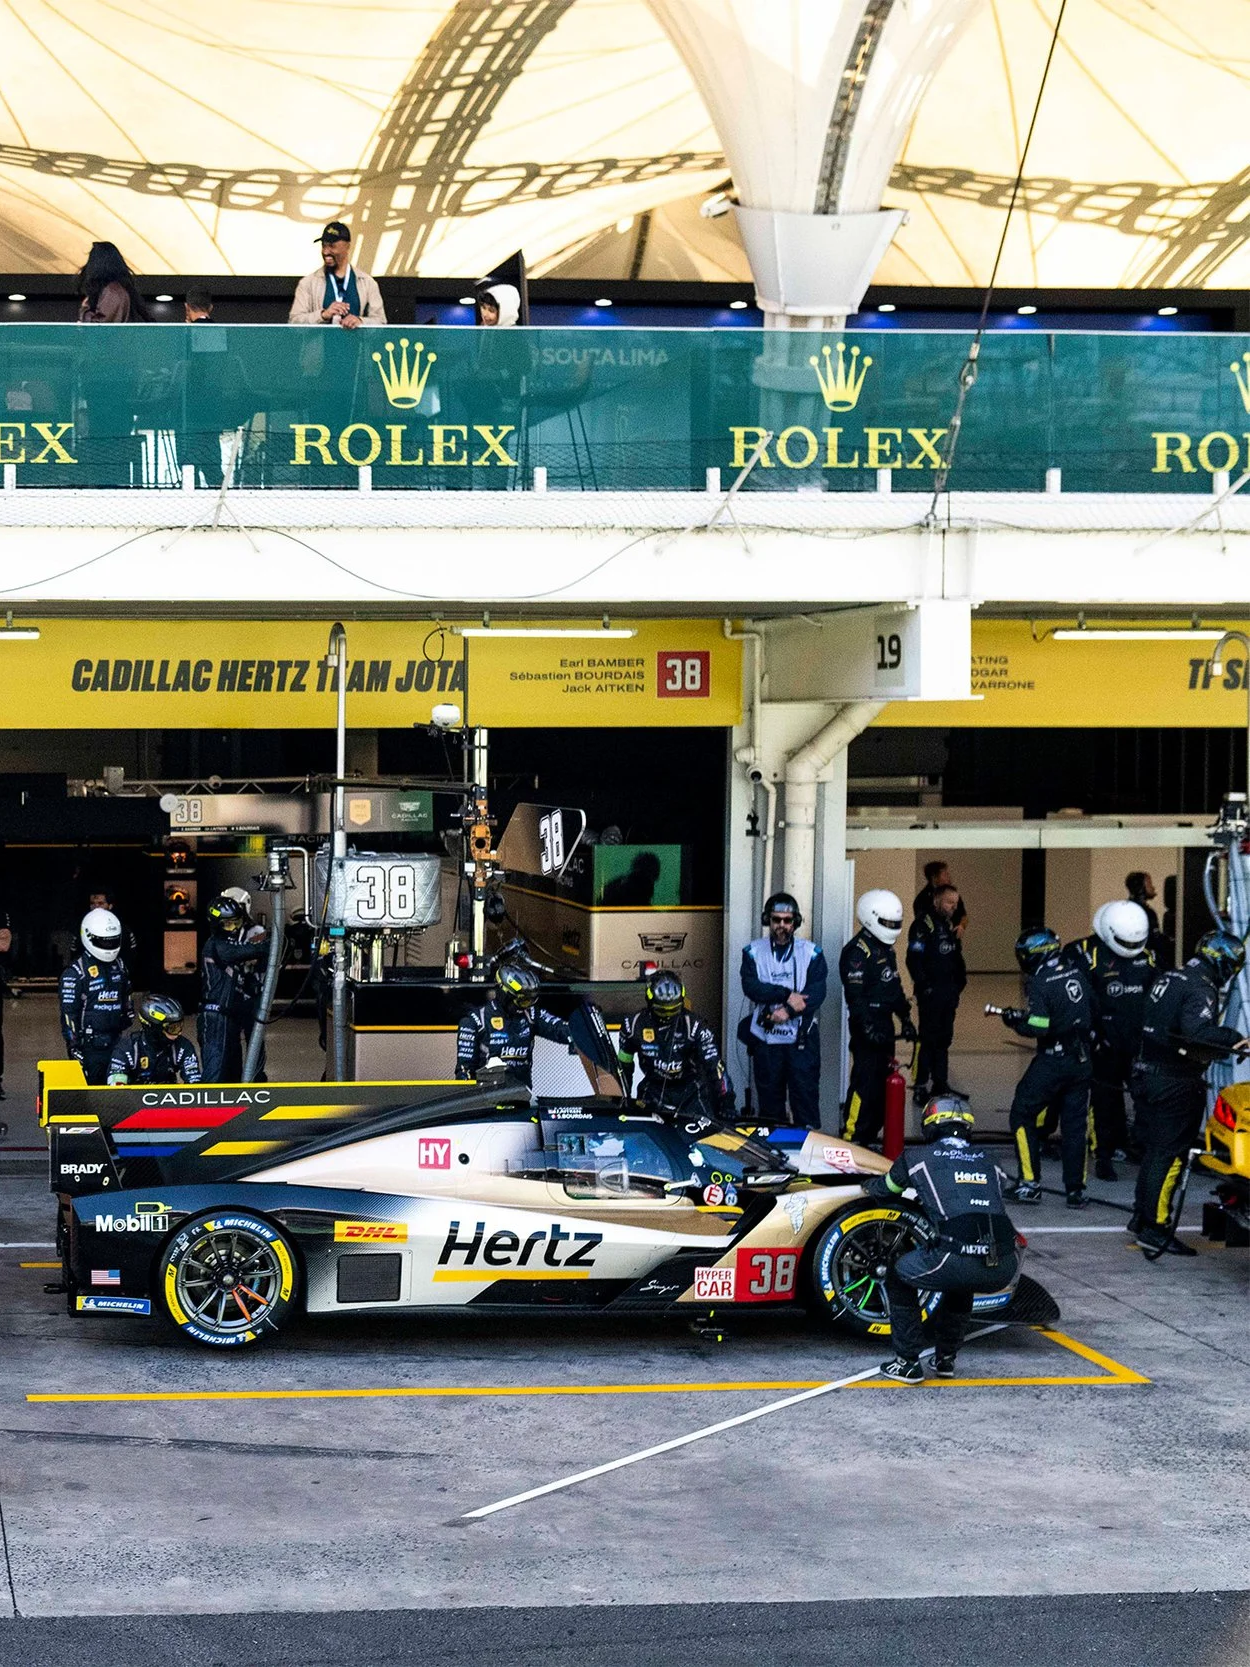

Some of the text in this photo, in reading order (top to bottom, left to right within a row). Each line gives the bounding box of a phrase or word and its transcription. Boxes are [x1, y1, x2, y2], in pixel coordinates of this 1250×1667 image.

[289, 424, 517, 466] ROLEX
[728, 427, 949, 469] ROLEX
[1151, 432, 1250, 473] RO
[877, 635, 901, 669] 19
[560, 659, 645, 667] Earl BAMBER
[71, 659, 213, 692] CADILLAC
[217, 660, 310, 692] HERTZ
[395, 660, 465, 693] JOTA
[510, 671, 645, 680] Sébastien BOURDAIS
[666, 659, 701, 690] 38
[562, 684, 645, 693] Jack AITKEN
[175, 799, 202, 823] 38
[539, 809, 564, 876] 38
[357, 865, 416, 920] 38
[98, 991, 118, 1000] Hertz
[501, 1046, 528, 1056] Hertz
[654, 1060, 683, 1071] Hertz
[142, 1091, 271, 1105] CADILLAC
[758, 1128, 769, 1136] 38
[420, 1143, 449, 1166] HY
[60, 1164, 103, 1174] BRADY
[955, 1171, 987, 1181] Hertz
[95, 1214, 150, 1232] Mobil
[224, 1219, 273, 1239] MICHELIN
[345, 1226, 398, 1240] DHL
[437, 1221, 603, 1268] Hertz
[821, 1231, 840, 1280] MICHELIN
[697, 1271, 732, 1281] HYPER
[750, 1254, 797, 1294] 38
[696, 1281, 733, 1297] CAR
[96, 1300, 144, 1310] MICHELIN
[187, 1326, 235, 1344] MICHELIN
